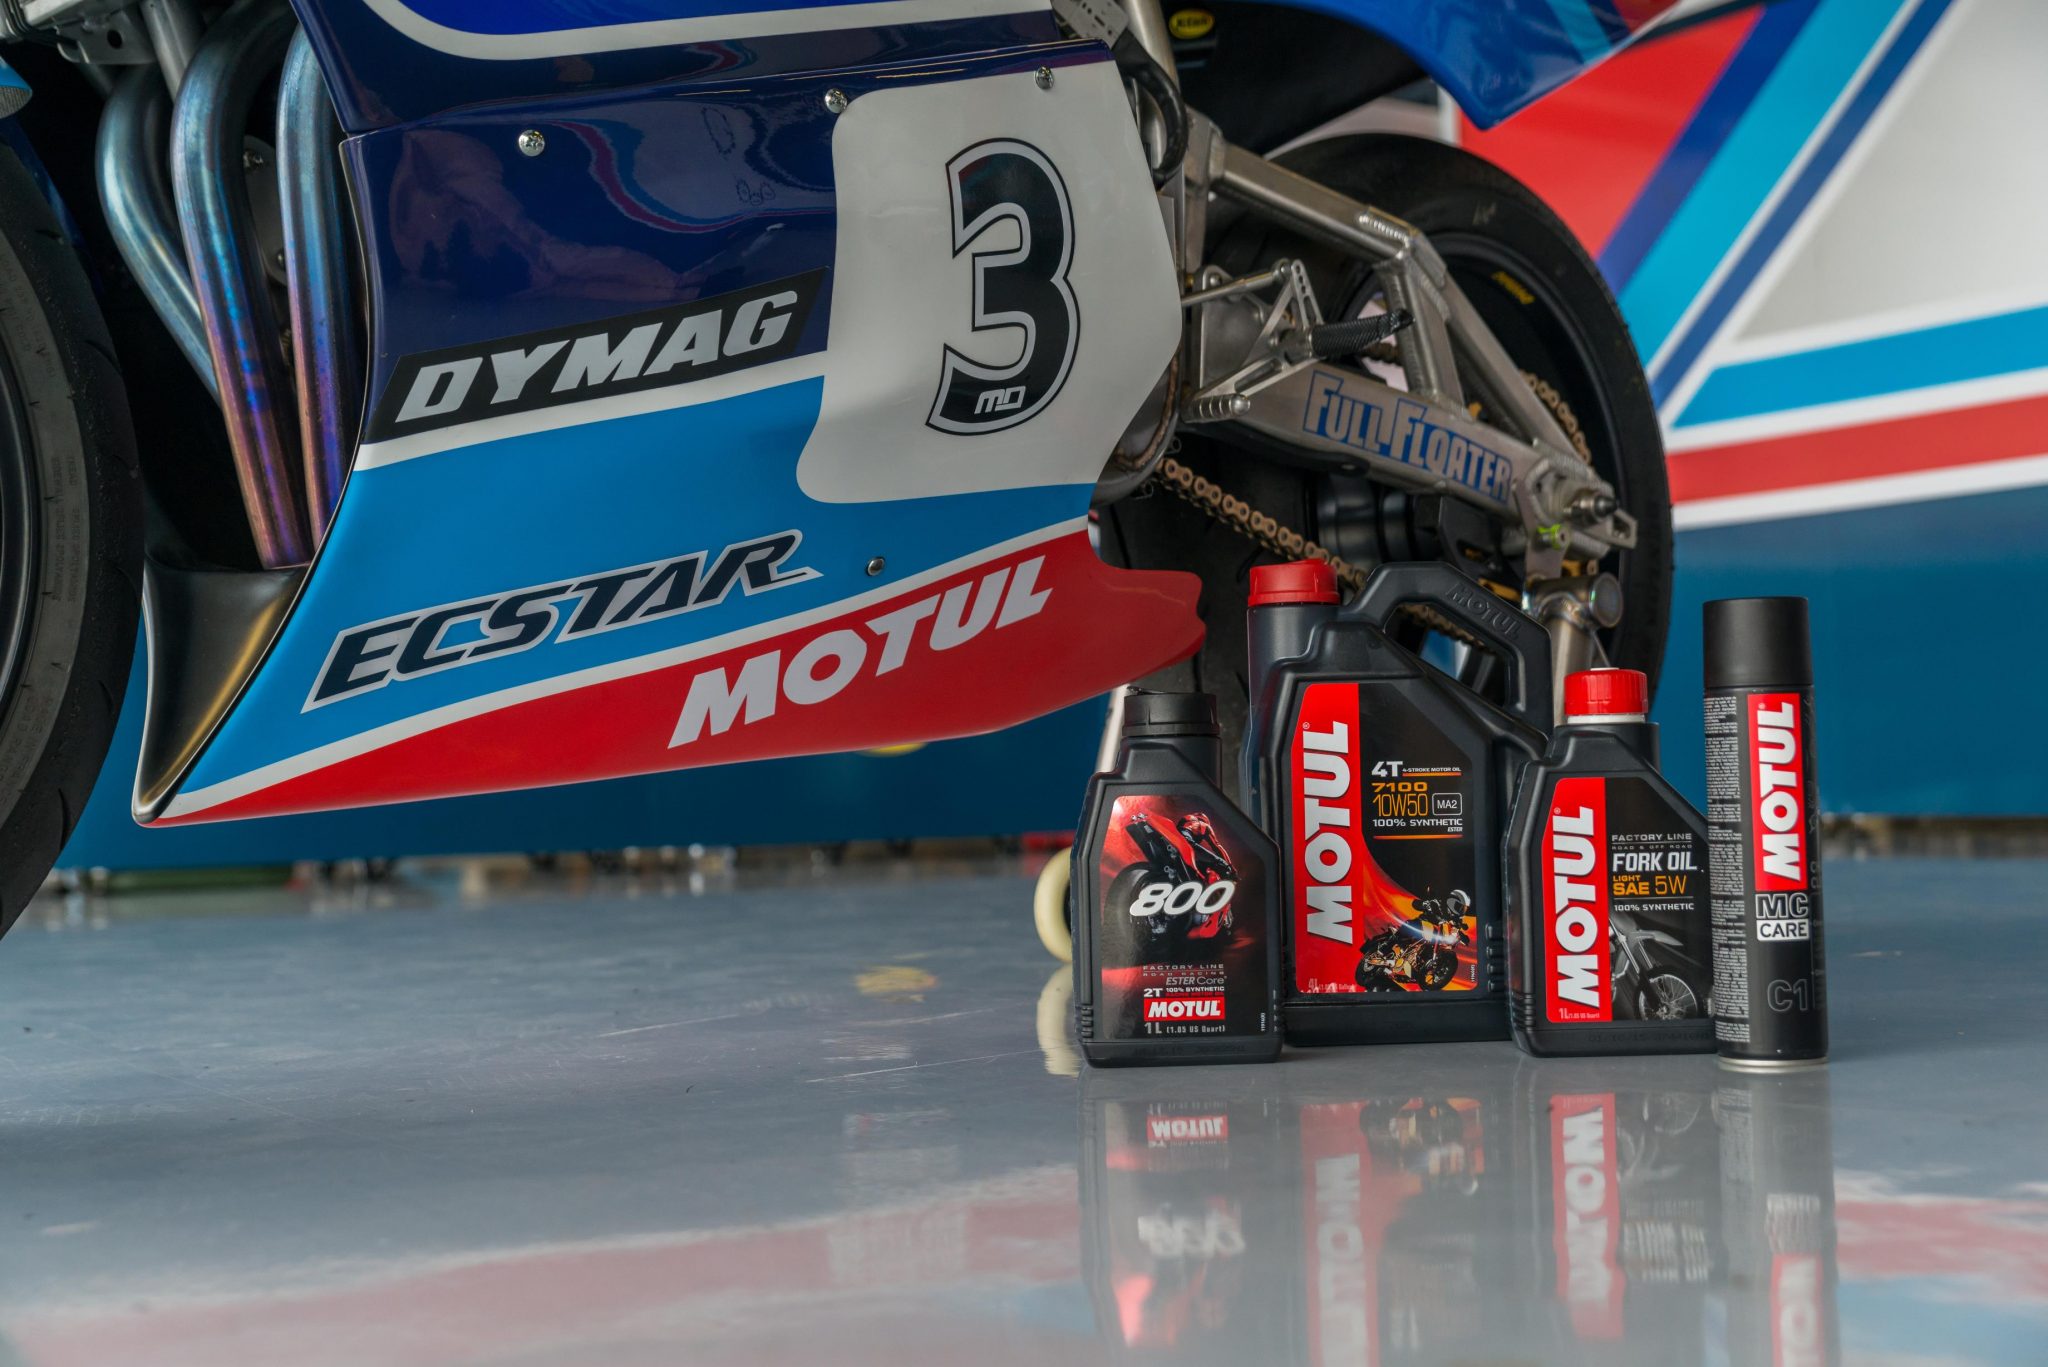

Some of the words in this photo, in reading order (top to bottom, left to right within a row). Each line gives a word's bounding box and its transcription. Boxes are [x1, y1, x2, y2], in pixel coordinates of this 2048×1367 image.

[925, 137, 1081, 436] 3
[395, 290, 798, 423] DYMAG
[1303, 370, 1383, 453] FULL
[1389, 397, 1512, 505] FLOATER
[300, 528, 825, 714] ECSTAR
[1445, 582, 1520, 640] MOTUL
[667, 555, 1053, 749] MOTUL
[1371, 760, 1403, 778] 4T
[1371, 781, 1428, 793] 7100
[1757, 701, 1801, 881] MOTUL
[1372, 794, 1429, 817] 10W50
[1437, 800, 1458, 809] MA2
[1303, 720, 1353, 945] MOTUL
[1373, 818, 1406, 827] 100%
[1410, 818, 1463, 827] SYNTHETIC
[1611, 833, 1663, 842] FACTORY
[1667, 832, 1692, 841] LINE
[1612, 851, 1664, 872] FORK
[1667, 851, 1698, 871] OIL
[1612, 874, 1641, 882] LIGHT
[1613, 881, 1650, 896] SAE
[1655, 874, 1687, 895] 5W
[1129, 881, 1236, 917] 800
[1552, 806, 1600, 1009] MOTUL
[1614, 904, 1640, 912] 100%
[1642, 903, 1695, 911] SYNTHETIC
[1755, 892, 1809, 920] MC
[1759, 921, 1808, 939] CARE
[1165, 976, 1195, 986] ESTER
[1143, 987, 1163, 998] 2T
[1767, 978, 1809, 1012] C1
[1148, 1000, 1221, 1018] MOTUL
